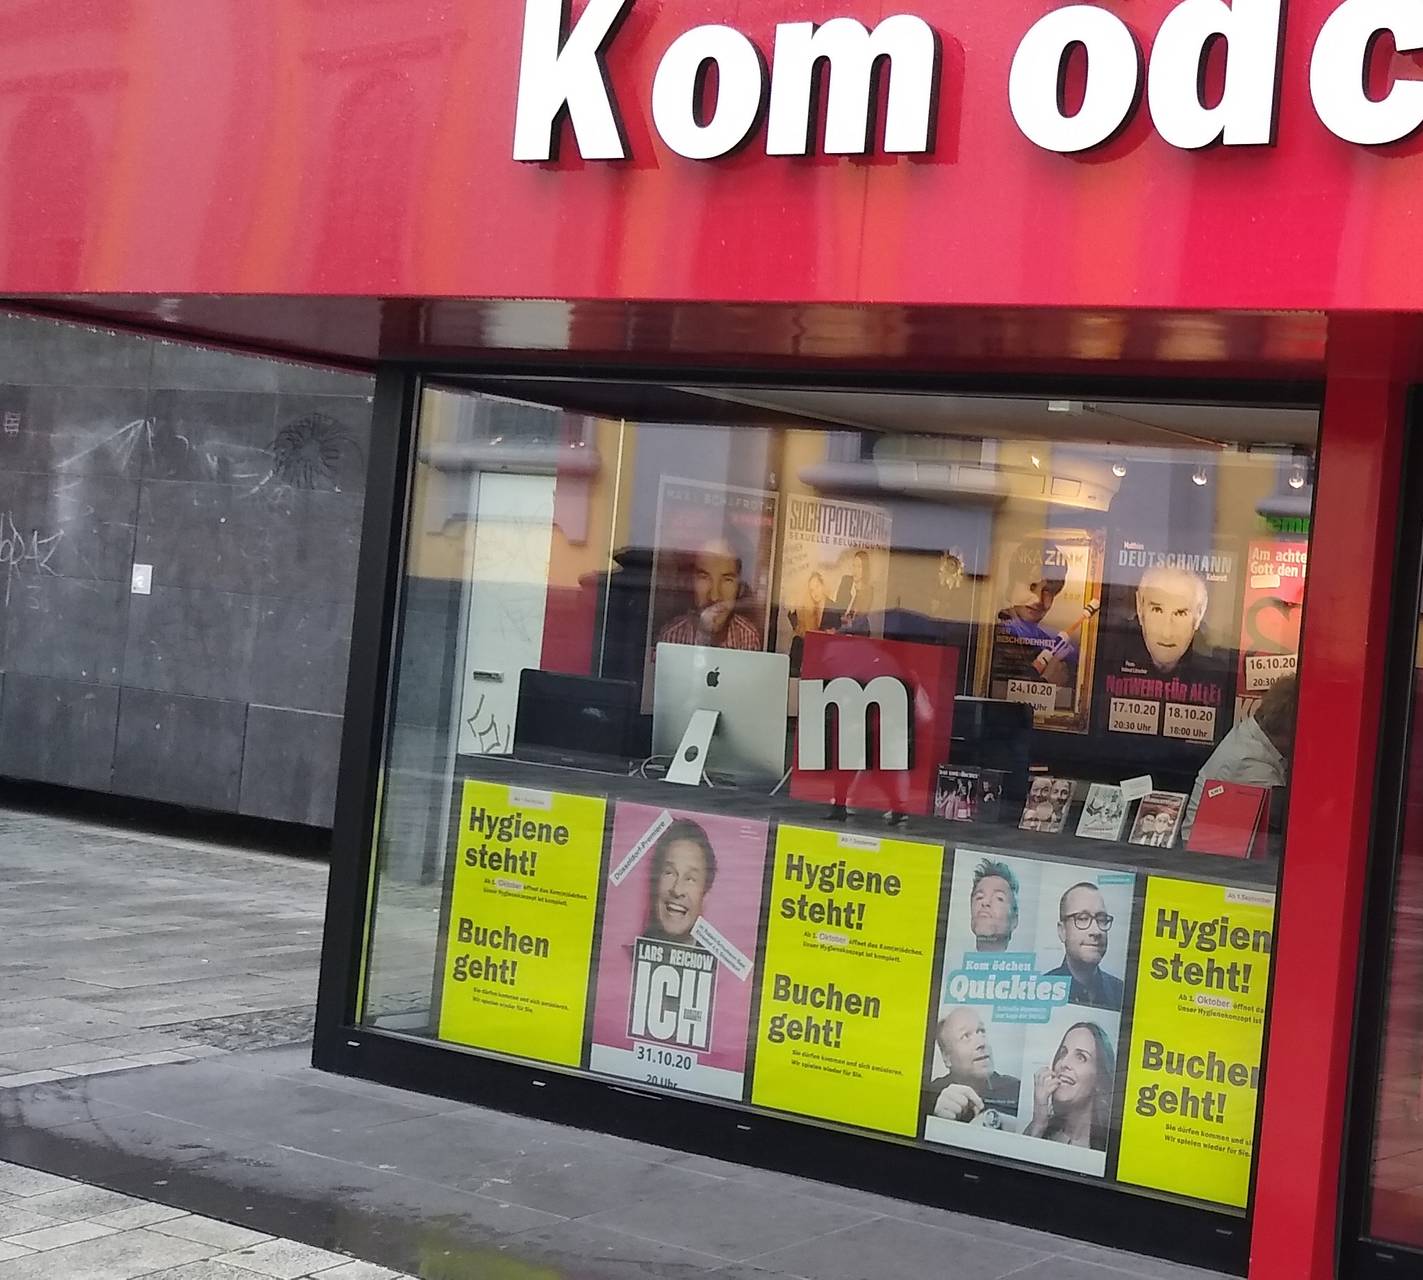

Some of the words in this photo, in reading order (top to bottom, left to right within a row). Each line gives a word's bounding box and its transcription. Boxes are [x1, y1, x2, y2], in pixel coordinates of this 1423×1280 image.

[512, 0, 938, 160] Kom
[1119, 549, 1232, 574] DEUTSCHMANN
[1251, 546, 1271, 561] Am
[1250, 560, 1275, 575] Gott
[1277, 562, 1299, 577] den
[1249, 656, 1296, 670] 16.10.20
[1010, 681, 1053, 697] 24.10.20
[1113, 701, 1156, 716] 17.10.20
[1168, 706, 1213, 722] 18.10.20
[798, 676, 909, 770] m
[1113, 719, 1136, 730] 20:30
[1137, 721, 1152, 731] Uhr
[1170, 726, 1191, 737] 18:00
[1192, 727, 1208, 738] Uhr
[469, 806, 569, 846] Hygiene
[464, 844, 538, 877] steht!
[784, 853, 902, 897] Hygiene
[780, 894, 866, 931] steht!
[457, 917, 549, 958] Buchen
[638, 943, 664, 962] LARS
[669, 948, 714, 971] REICHOW
[453, 953, 518, 986] geht!
[965, 960, 989, 971] Kom
[992, 959, 1031, 972] ödchen
[1150, 953, 1253, 994] steht!
[773, 973, 881, 1018] Buchen
[949, 974, 1066, 1003] Quickies
[631, 960, 712, 1048] ICH
[1178, 1004, 1197, 1013] Unser
[1197, 1007, 1252, 1024] Hygienekonzept
[1197, 995, 1231, 1009] Oktober
[1233, 1002, 1255, 1013] öffnet
[768, 1013, 844, 1049] geht!
[637, 1045, 692, 1071] 31.10.20
[1135, 1083, 1227, 1124] geht!
[1164, 1134, 1176, 1143] Wir
[1177, 1137, 1202, 1149] spielen
[1203, 1142, 1226, 1153] wieder
[1165, 1123, 1176, 1132] Sie
[1177, 1126, 1200, 1137] dürfen
[1200, 1130, 1230, 1143] kommen
[1230, 1136, 1244, 1146] und
